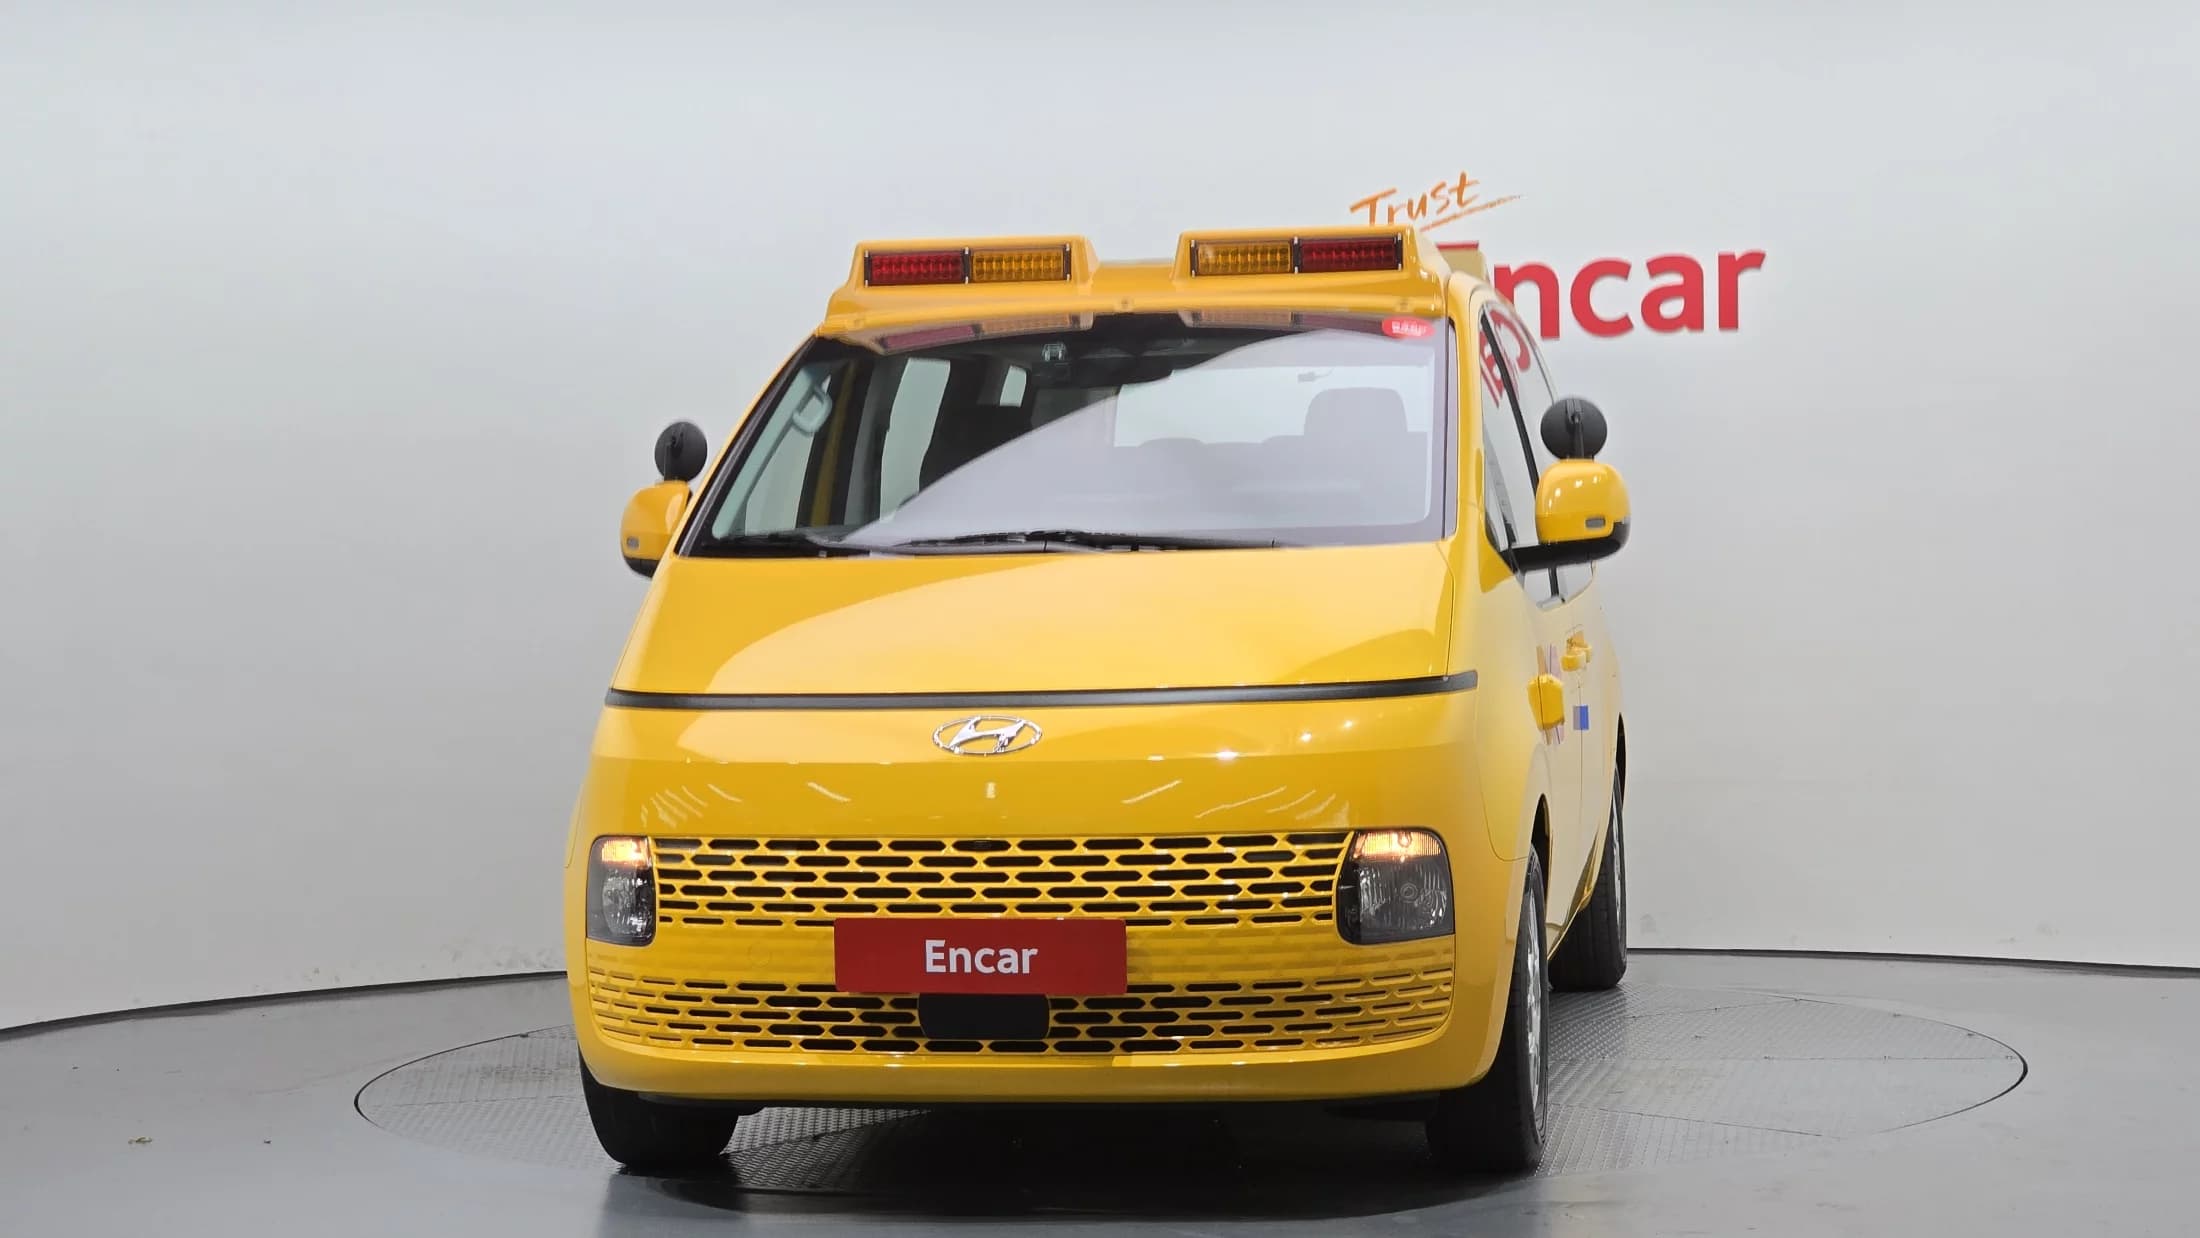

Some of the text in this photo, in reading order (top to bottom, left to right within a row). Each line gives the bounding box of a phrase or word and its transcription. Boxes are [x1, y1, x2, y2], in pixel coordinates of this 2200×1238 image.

[1350, 171, 1479, 226] Trust
[1436, 241, 1766, 339] ncar
[925, 939, 1038, 974] Encar
